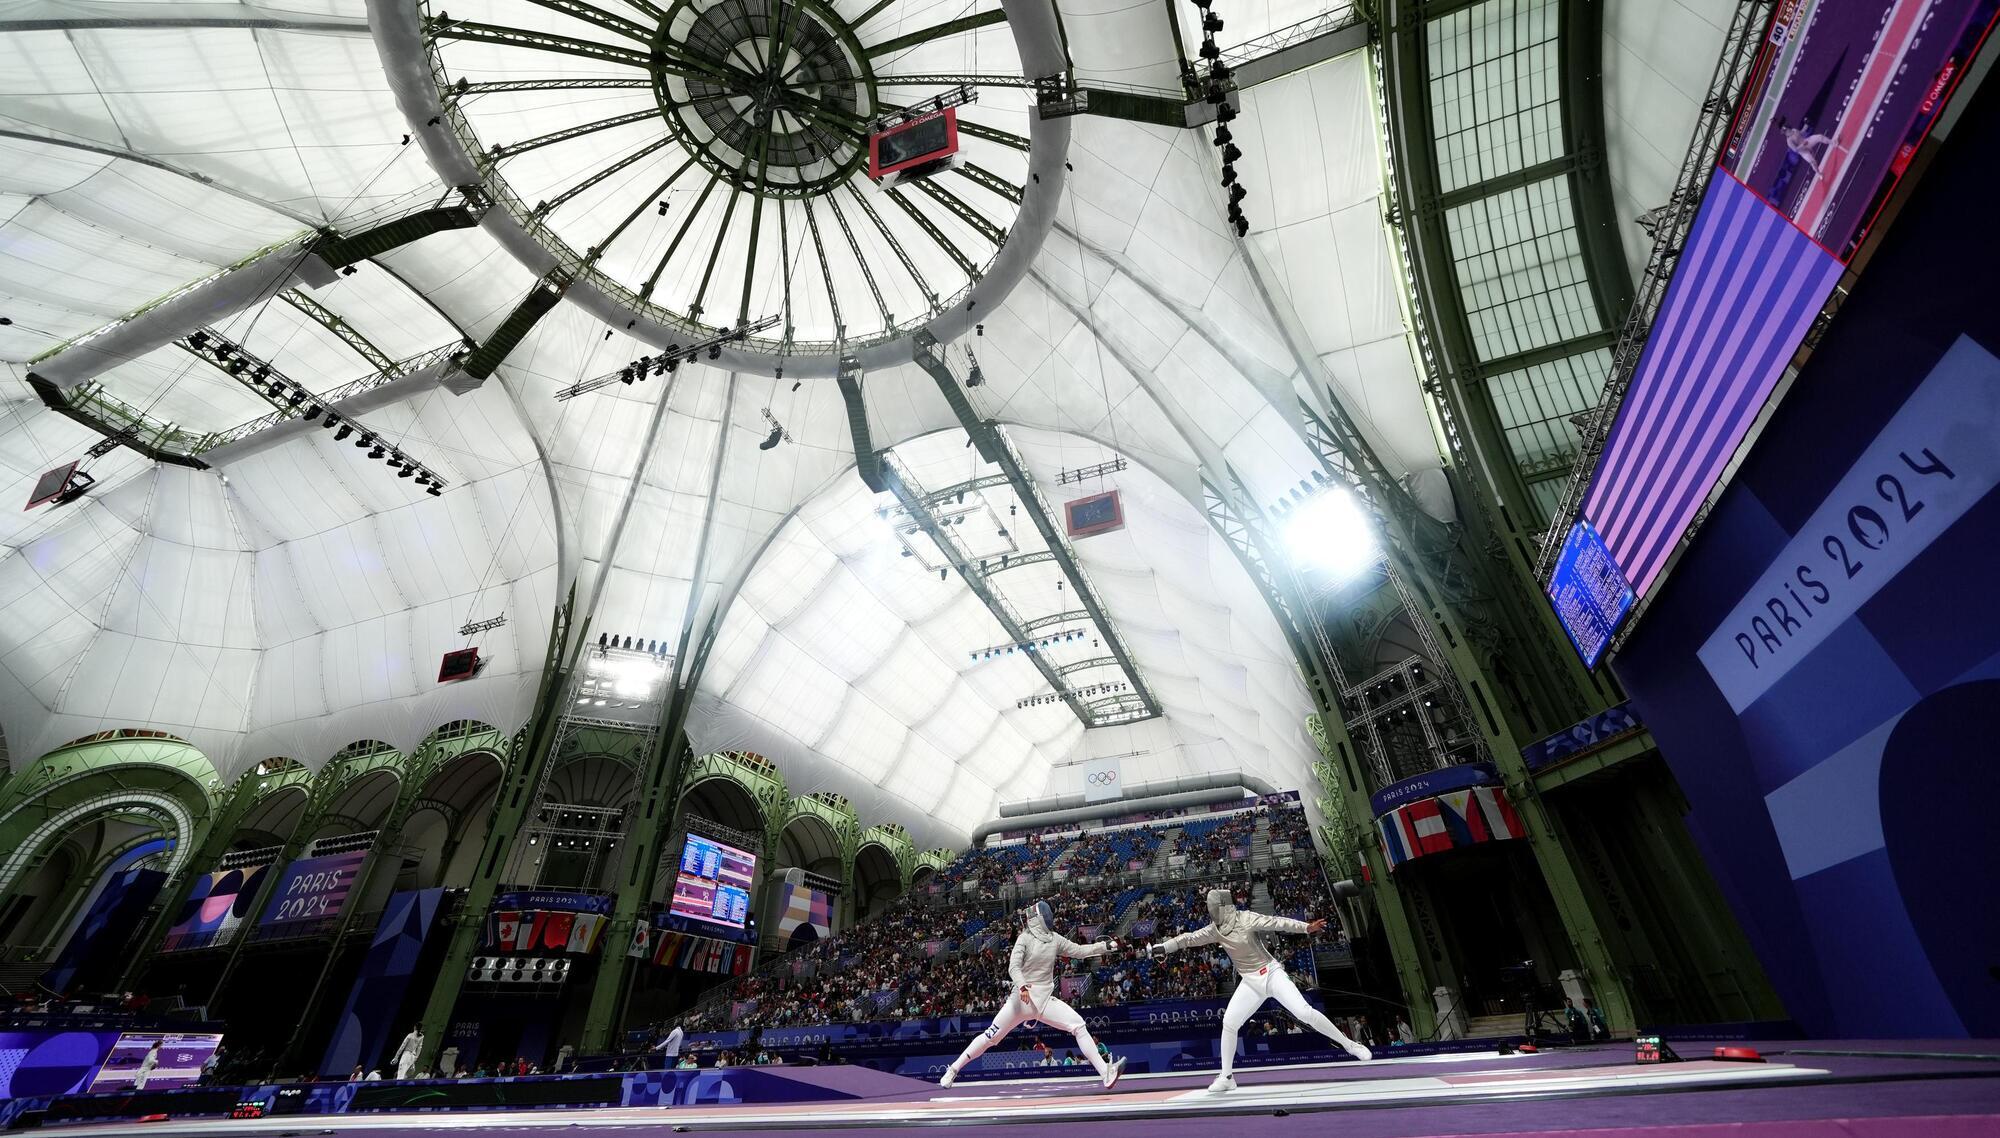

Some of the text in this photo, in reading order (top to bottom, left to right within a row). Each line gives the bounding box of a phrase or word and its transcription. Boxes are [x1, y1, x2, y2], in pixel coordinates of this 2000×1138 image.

[1773, 26, 1784, 42] 40
[1930, 66, 1955, 101] OMEGA
[919, 112, 944, 123] OMEGA
[1823, 447, 1956, 579] 2024
[1404, 780, 1430, 794] 2024
[274, 895, 329, 921] 2024
[985, 1023, 999, 1040] ITA
